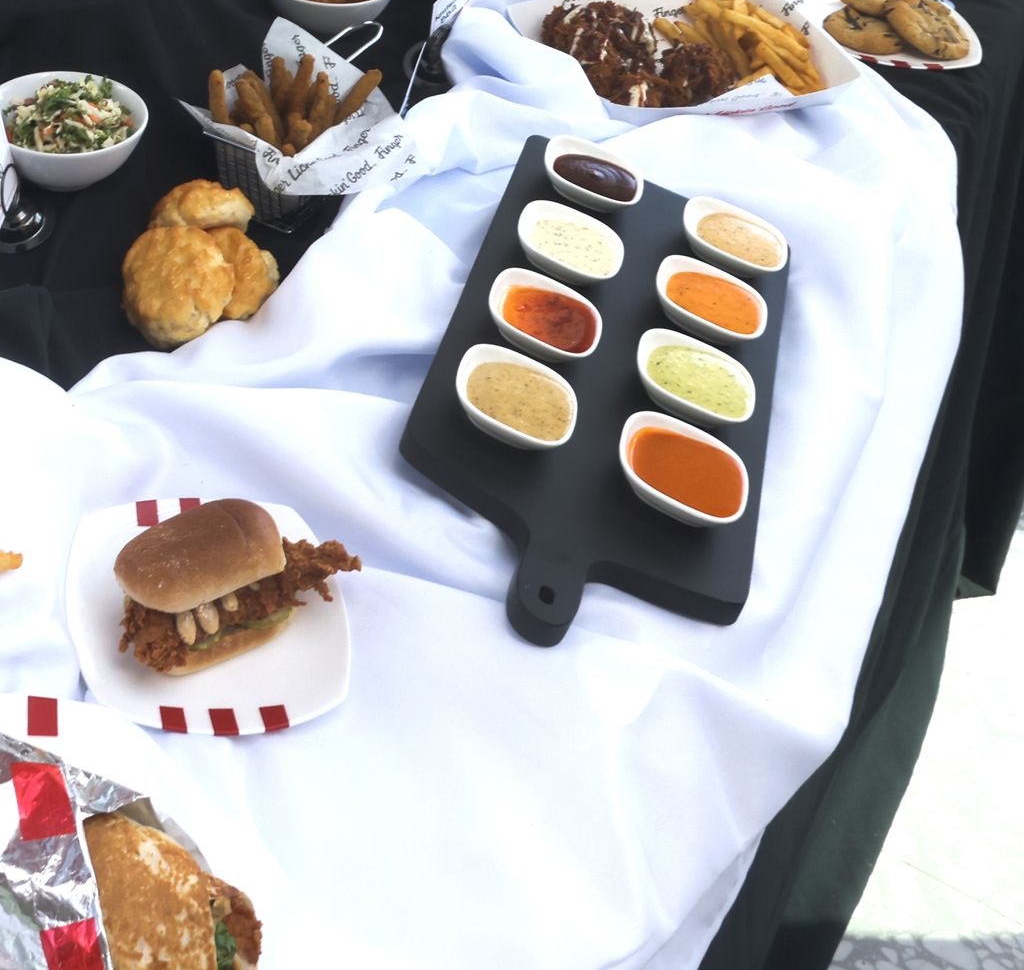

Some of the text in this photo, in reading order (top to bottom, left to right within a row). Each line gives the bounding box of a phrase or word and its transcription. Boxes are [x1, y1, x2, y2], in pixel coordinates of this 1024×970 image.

[652, 6, 682, 18] Finge
[374, 134, 403, 159] Finger
[347, 160, 373, 184] Good
